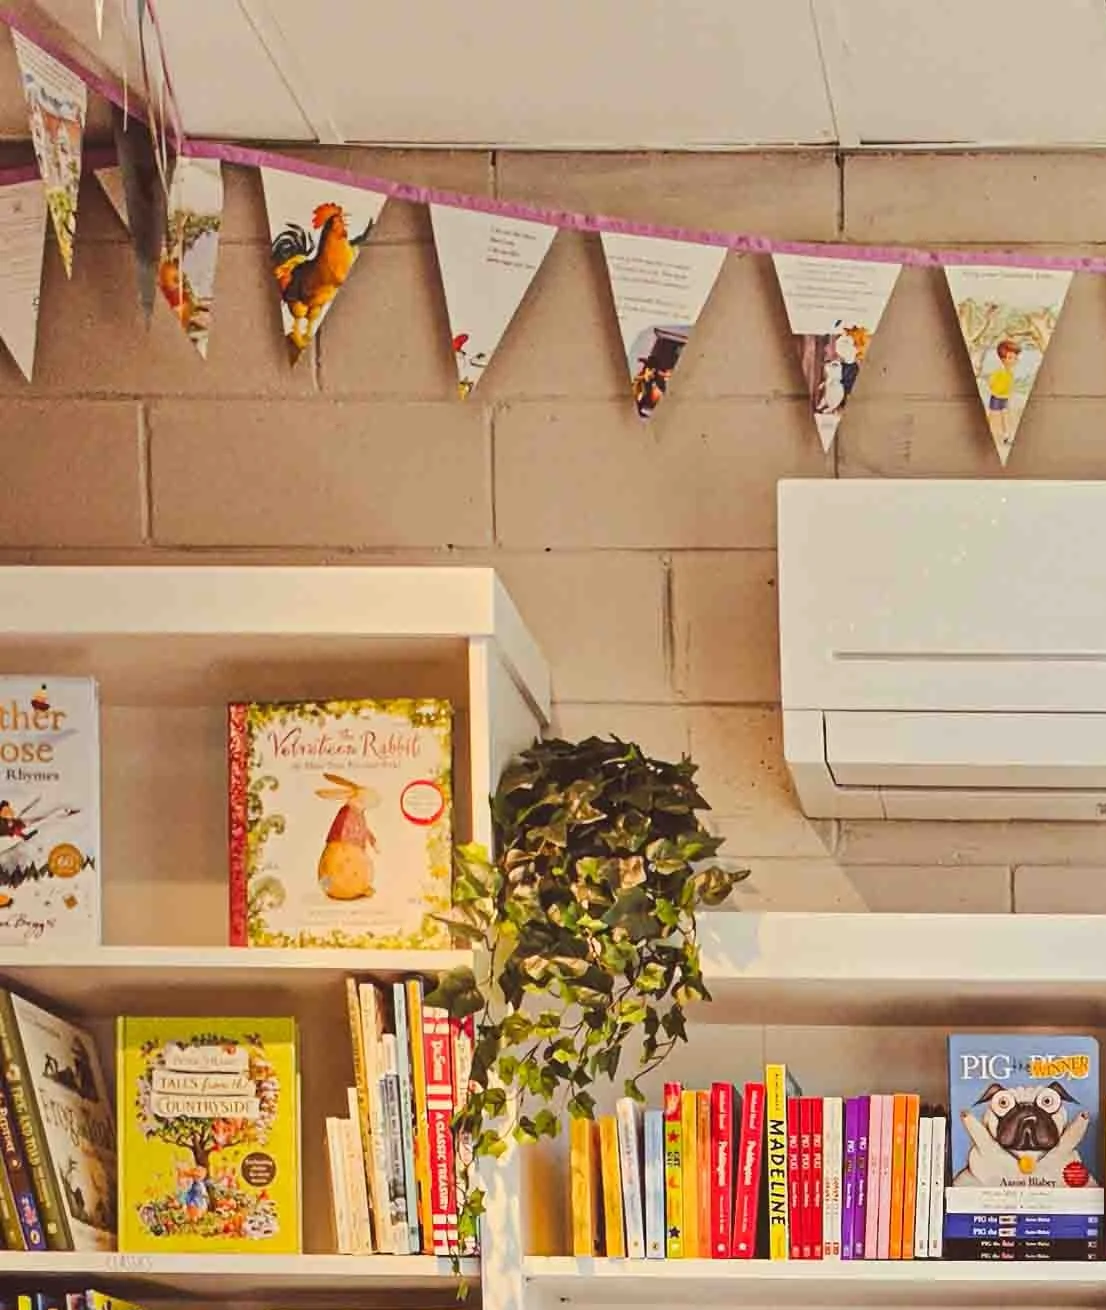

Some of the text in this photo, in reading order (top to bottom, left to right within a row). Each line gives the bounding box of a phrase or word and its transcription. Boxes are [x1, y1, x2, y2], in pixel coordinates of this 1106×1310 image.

[6, 769, 60, 782] Rhymes
[960, 1054, 1013, 1080] PIG
[158, 1100, 252, 1115] COUNTRYSIDE
[435, 1121, 447, 1161] CLASSIC
[770, 1119, 786, 1225] MADELINE
[1000, 1176, 1057, 1188] Aaron Blabey
[436, 1162, 449, 1211] TREASURY
